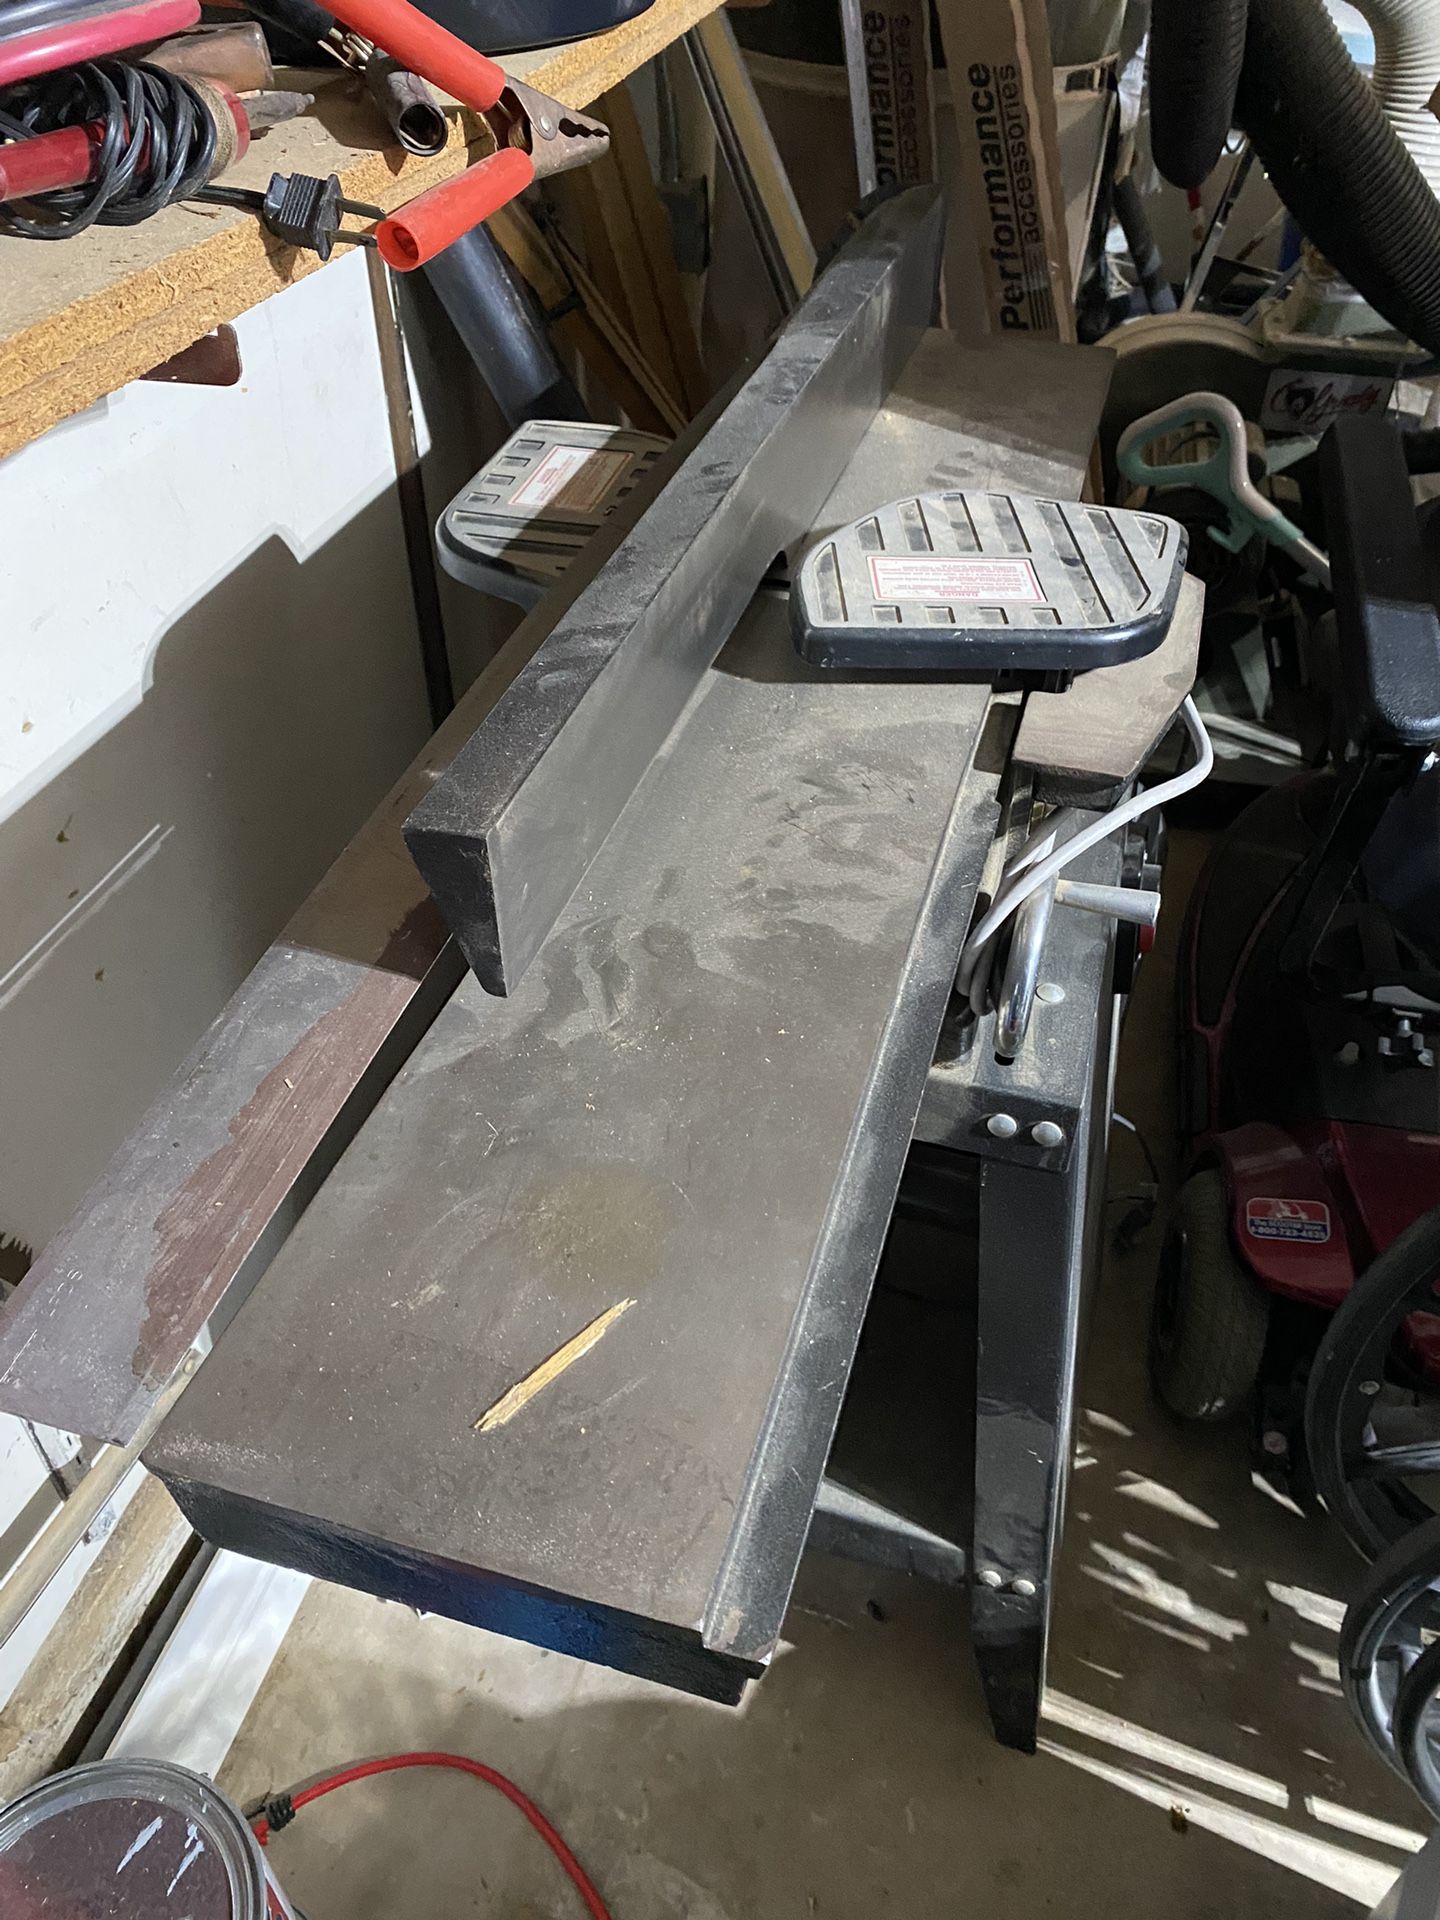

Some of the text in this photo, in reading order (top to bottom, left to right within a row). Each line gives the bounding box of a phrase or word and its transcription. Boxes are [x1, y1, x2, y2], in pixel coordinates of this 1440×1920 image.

[863, 9, 899, 187] ormance
[999, 64, 1041, 244] accessories
[967, 62, 1029, 332] Performance
